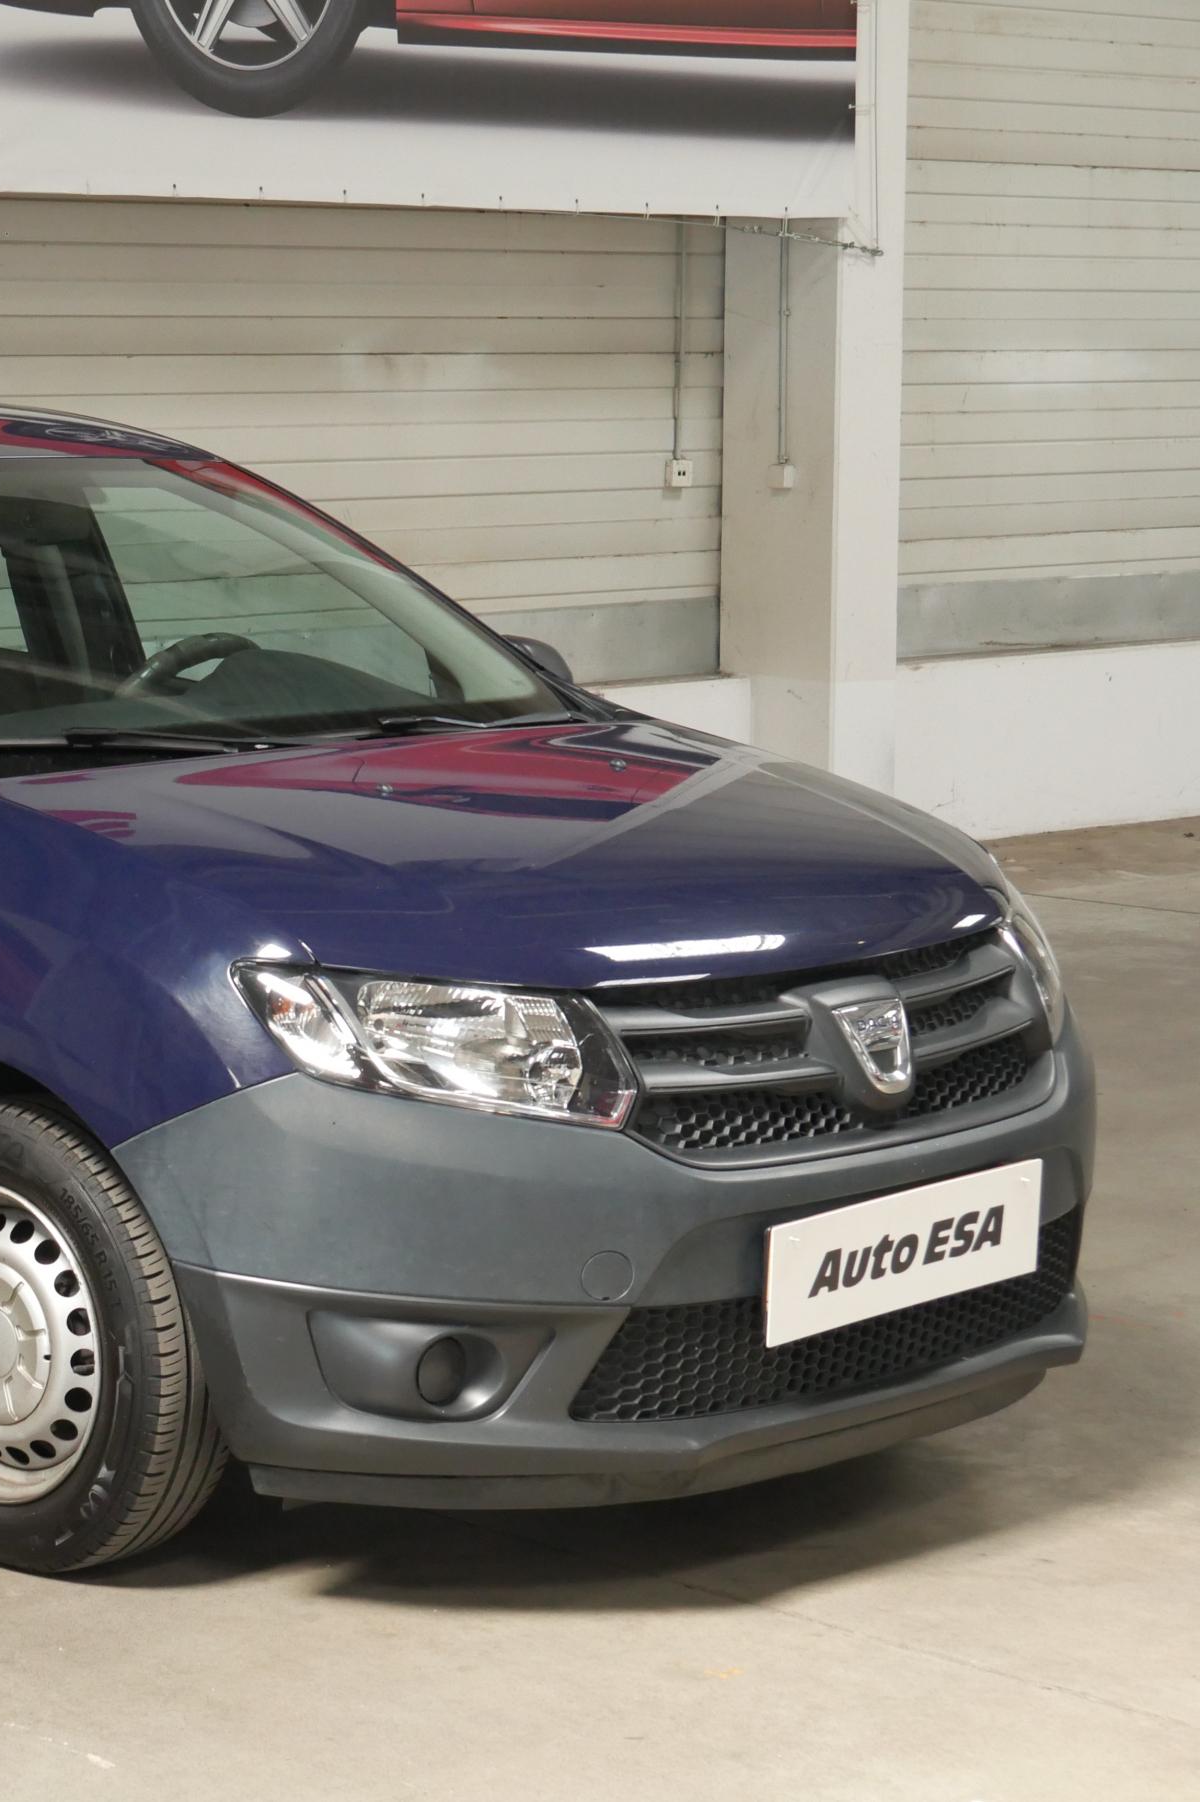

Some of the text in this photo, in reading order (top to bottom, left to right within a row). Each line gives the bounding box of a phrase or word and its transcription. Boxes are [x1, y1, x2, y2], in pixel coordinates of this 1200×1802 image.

[59, 1188, 100, 1245] 185/65
[95, 1250, 108, 1265] R
[808, 1204, 1005, 1299] Auto ESA
